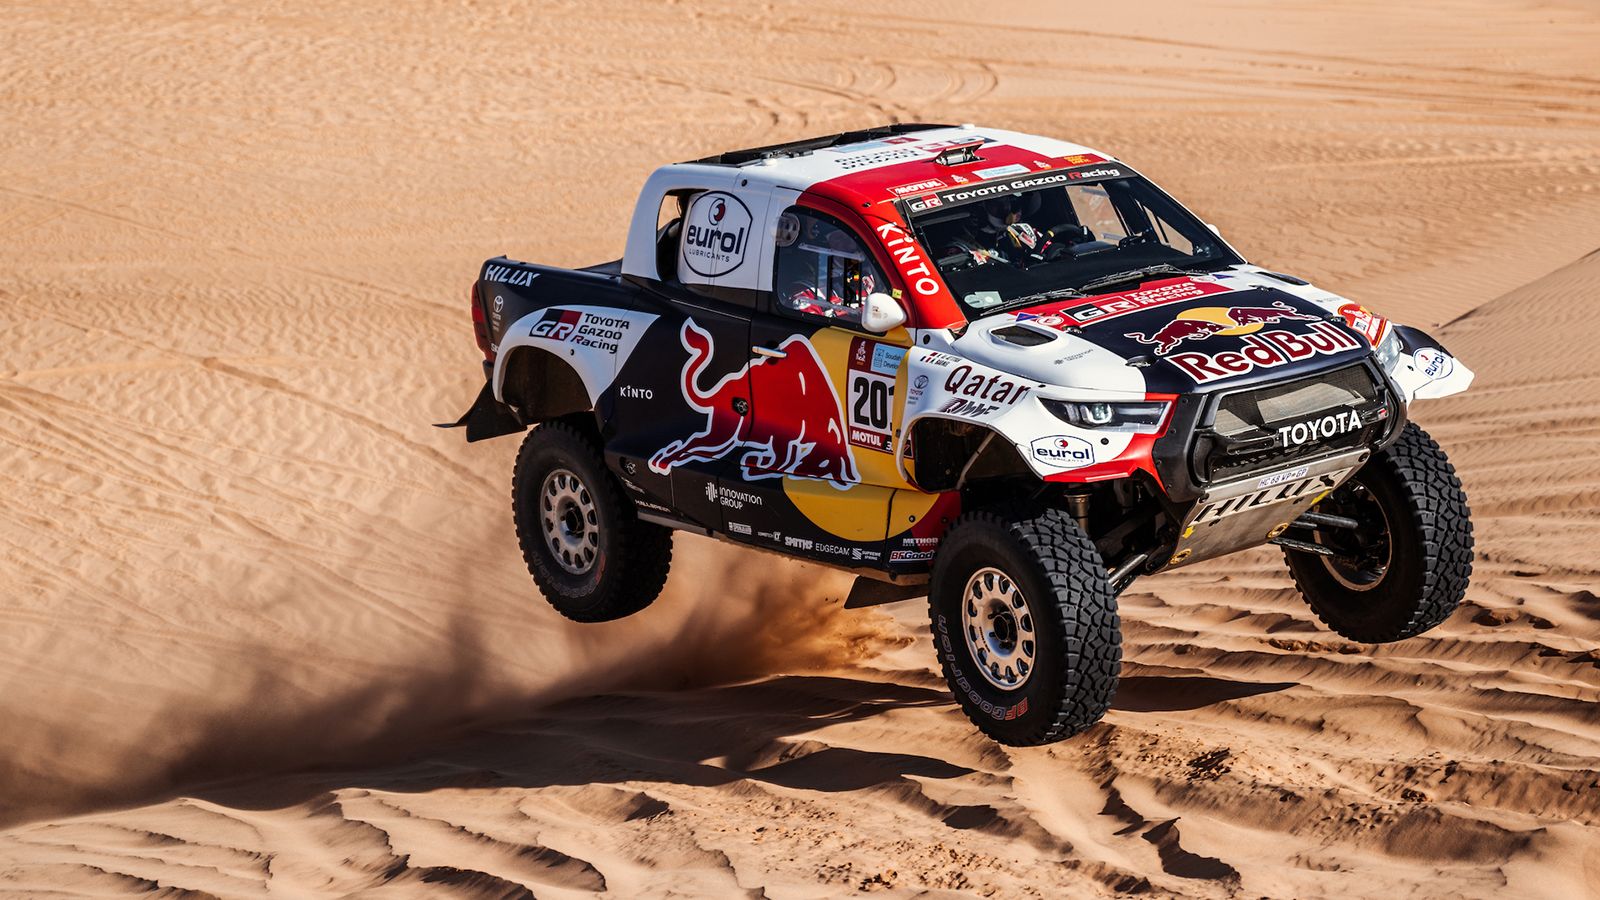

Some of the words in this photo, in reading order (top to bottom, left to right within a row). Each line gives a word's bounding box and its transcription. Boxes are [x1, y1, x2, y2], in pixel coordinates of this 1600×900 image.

[895, 180, 942, 194] MOTUL
[943, 185, 1009, 202] TOYOTA
[1011, 174, 1067, 189] GAZOO
[1068, 168, 1120, 180] Racing
[911, 198, 943, 212] GR
[686, 225, 744, 254] eurol
[688, 248, 730, 262] LUBRICANTS
[484, 264, 540, 287] HILUX
[1125, 282, 1195, 298] TOYOTA
[1134, 286, 1197, 301] GAZOO
[1140, 290, 1205, 305] Racing
[1073, 300, 1137, 320] GR
[585, 313, 630, 329] TOYOTA
[530, 320, 575, 341] GR
[578, 325, 623, 340] GAZOO
[570, 335, 619, 354] Racing
[1166, 334, 1286, 383] Red
[1262, 321, 1361, 363] Bull
[1424, 352, 1446, 377] eurol
[944, 365, 1031, 405] Qatar
[1279, 410, 1362, 447] TOYOTA
[851, 430, 882, 447] MOTUL
[1036, 448, 1090, 460] eurol
[719, 497, 743, 510] GROUP
[1190, 469, 1345, 523] HILUX
[784, 536, 813, 550] SMITHS
[815, 542, 850, 556] EDGECAM
[889, 550, 935, 561] BFGood
